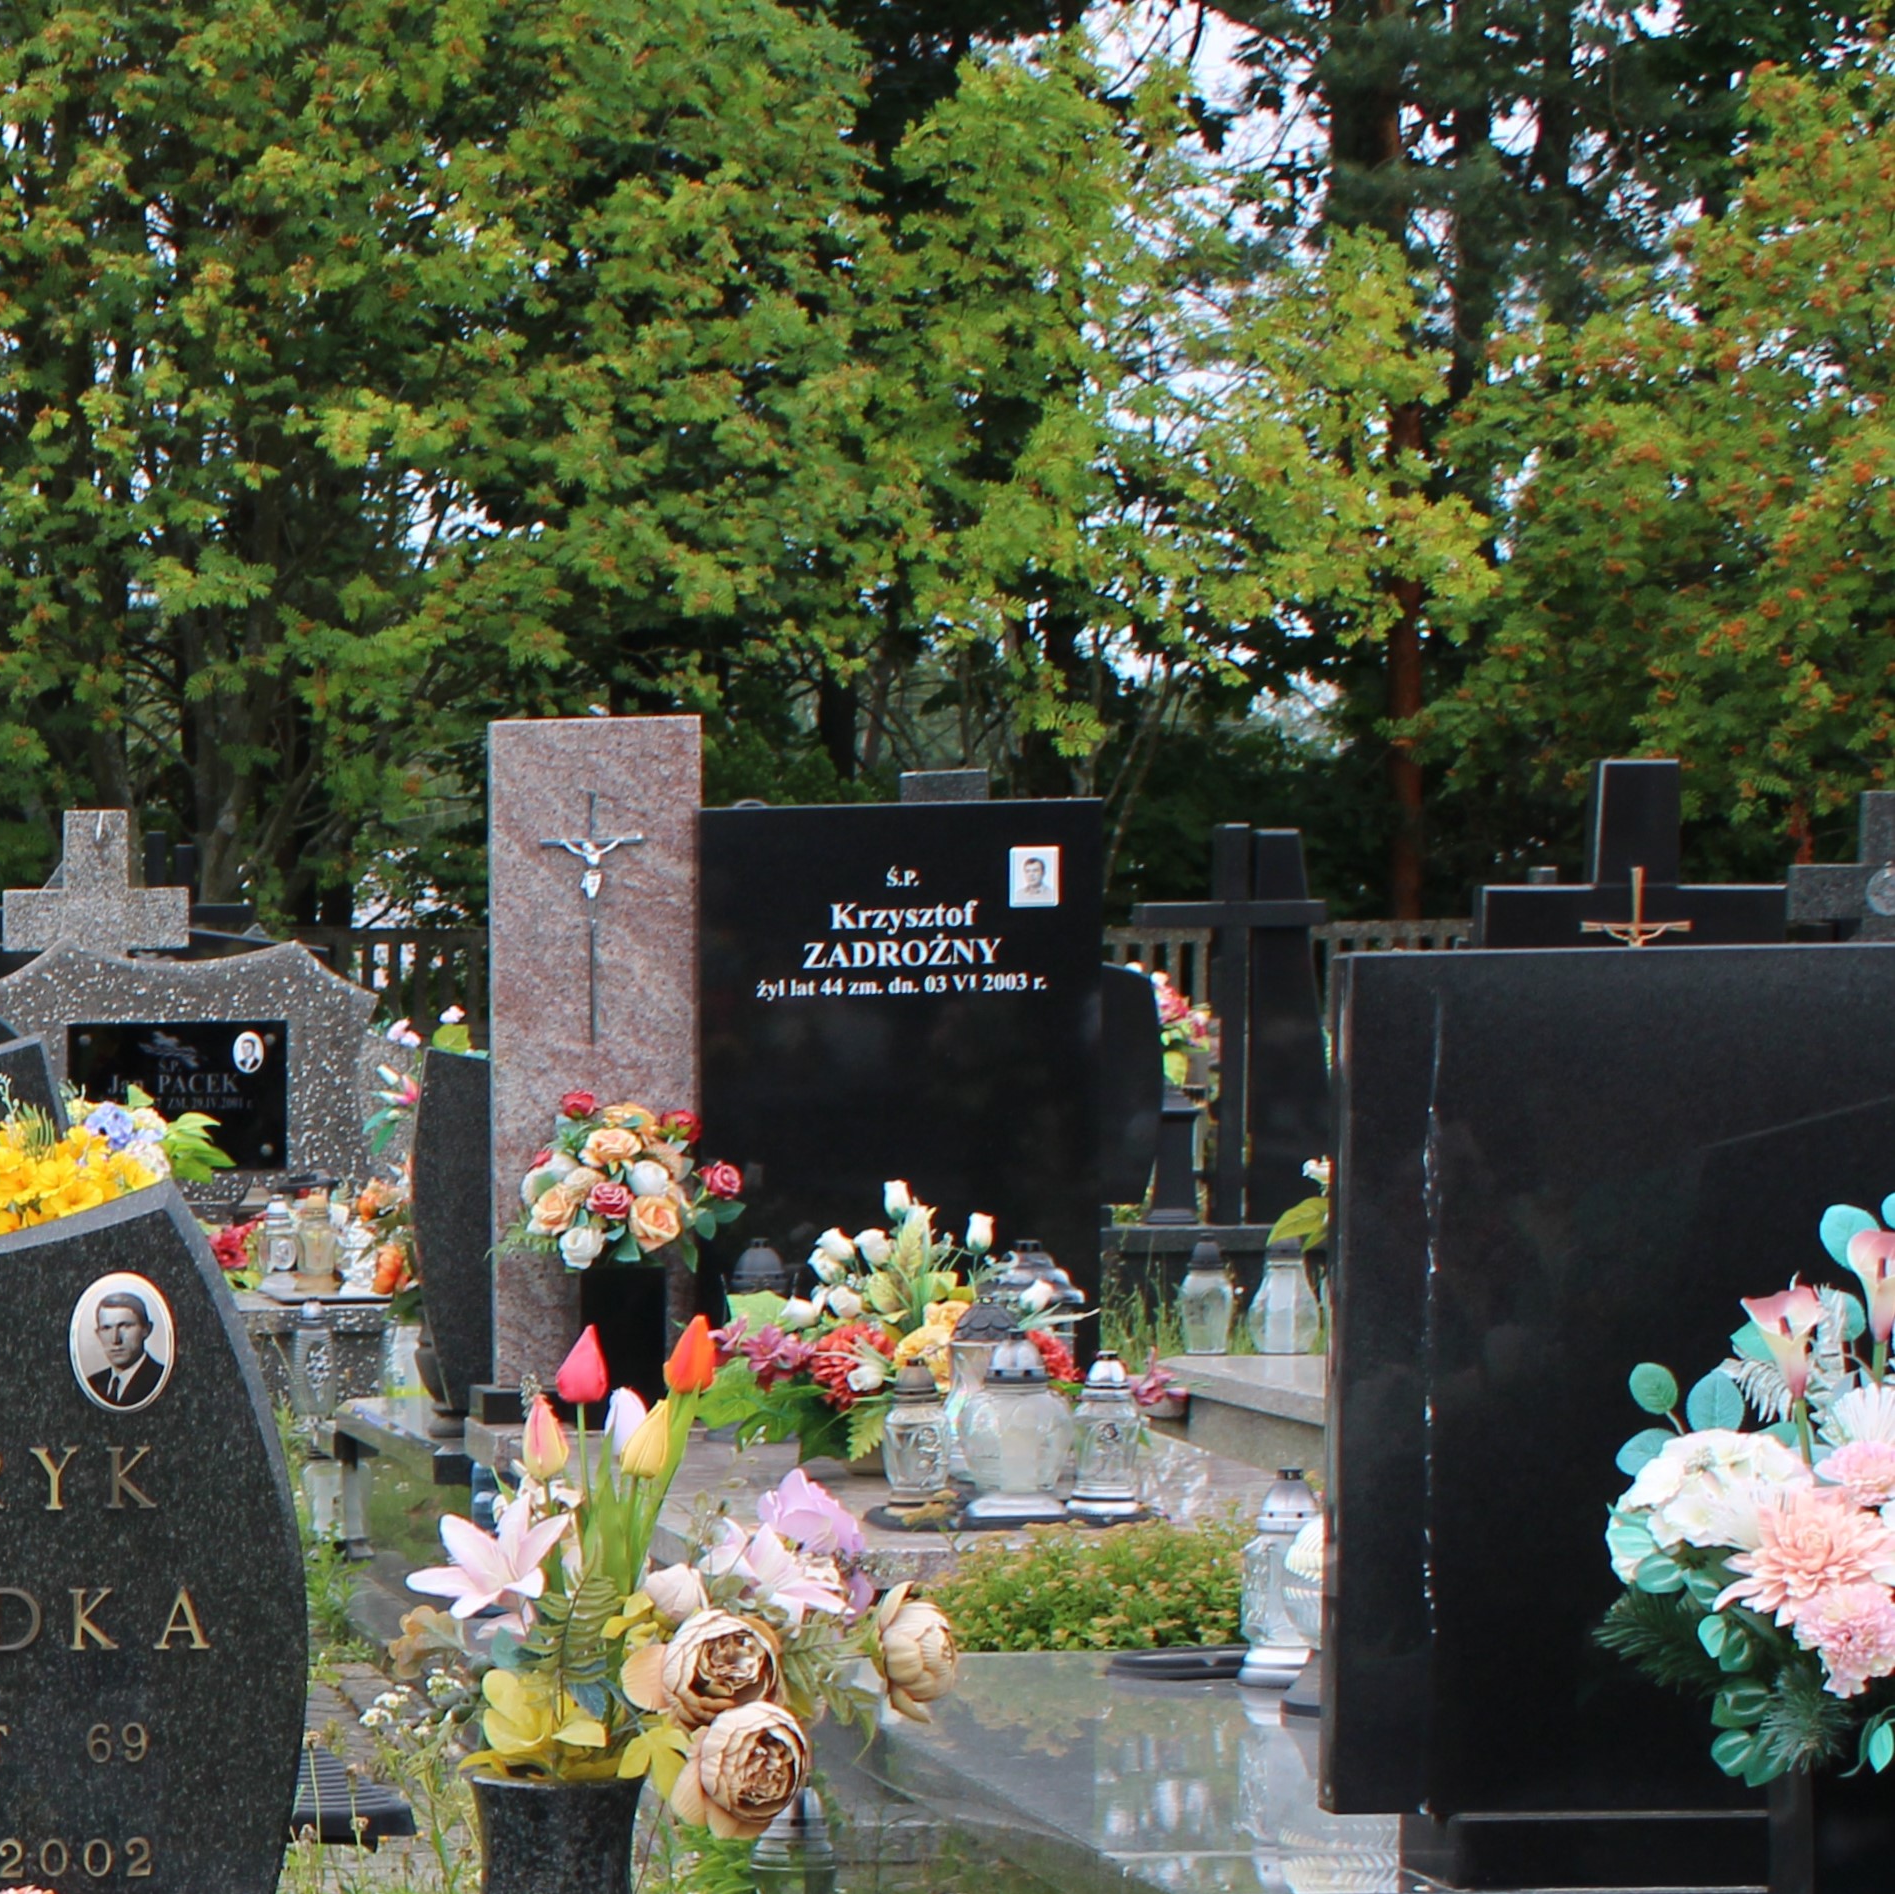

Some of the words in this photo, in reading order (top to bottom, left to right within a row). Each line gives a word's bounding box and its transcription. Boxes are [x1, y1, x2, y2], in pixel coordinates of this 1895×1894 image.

[886, 866, 920, 887] Ś.P.
[830, 900, 978, 935] Krzysztof
[802, 934, 1002, 969] ZADROŻNY
[790, 979, 816, 997] lat
[820, 978, 843, 996] 44
[848, 980, 883, 995] zm.
[888, 976, 919, 994] dn.
[924, 976, 947, 992] 03
[952, 974, 977, 991] VI
[982, 973, 1028, 991] 2003
[1033, 975, 1048, 990] r.
[158, 1073, 239, 1094] PACEK
[87, 1722, 150, 1762] 69
